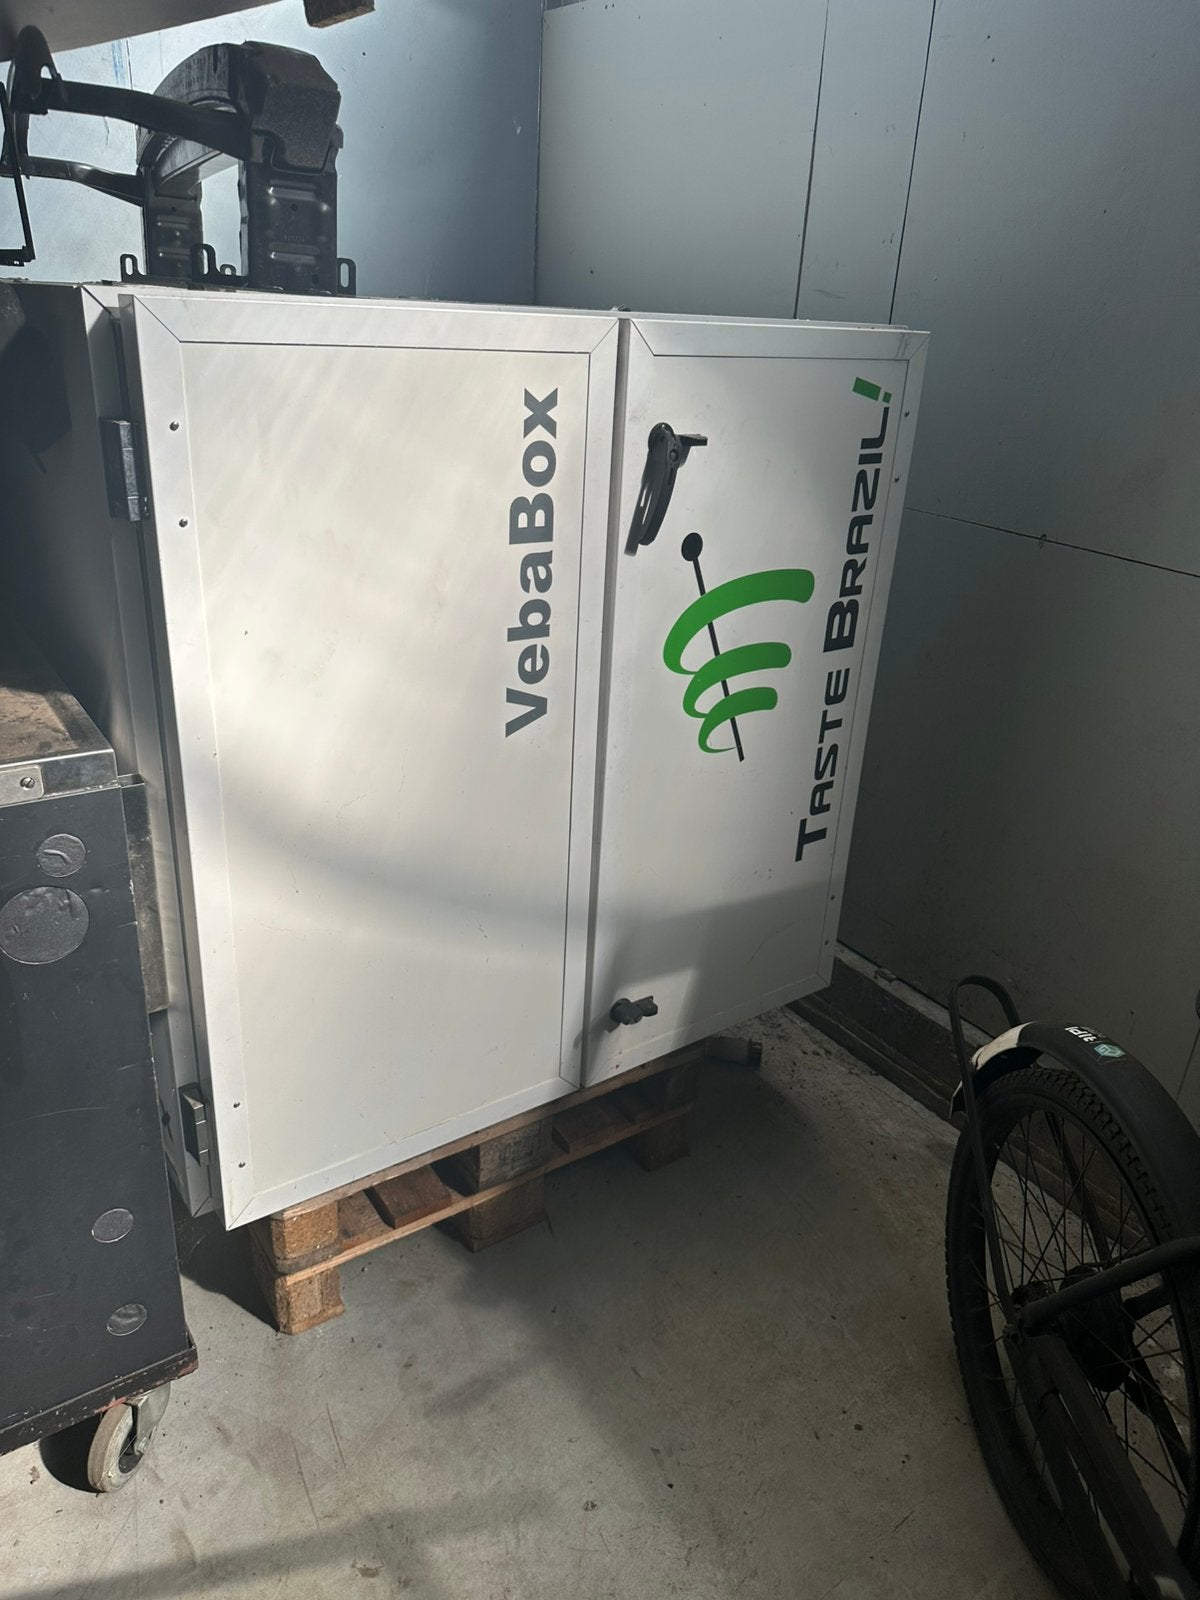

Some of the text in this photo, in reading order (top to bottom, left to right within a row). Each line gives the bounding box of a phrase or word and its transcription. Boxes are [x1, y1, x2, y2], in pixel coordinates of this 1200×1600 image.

[505, 387, 558, 738] VebaBox
[795, 376, 893, 862] TASTE BRAZIL!
